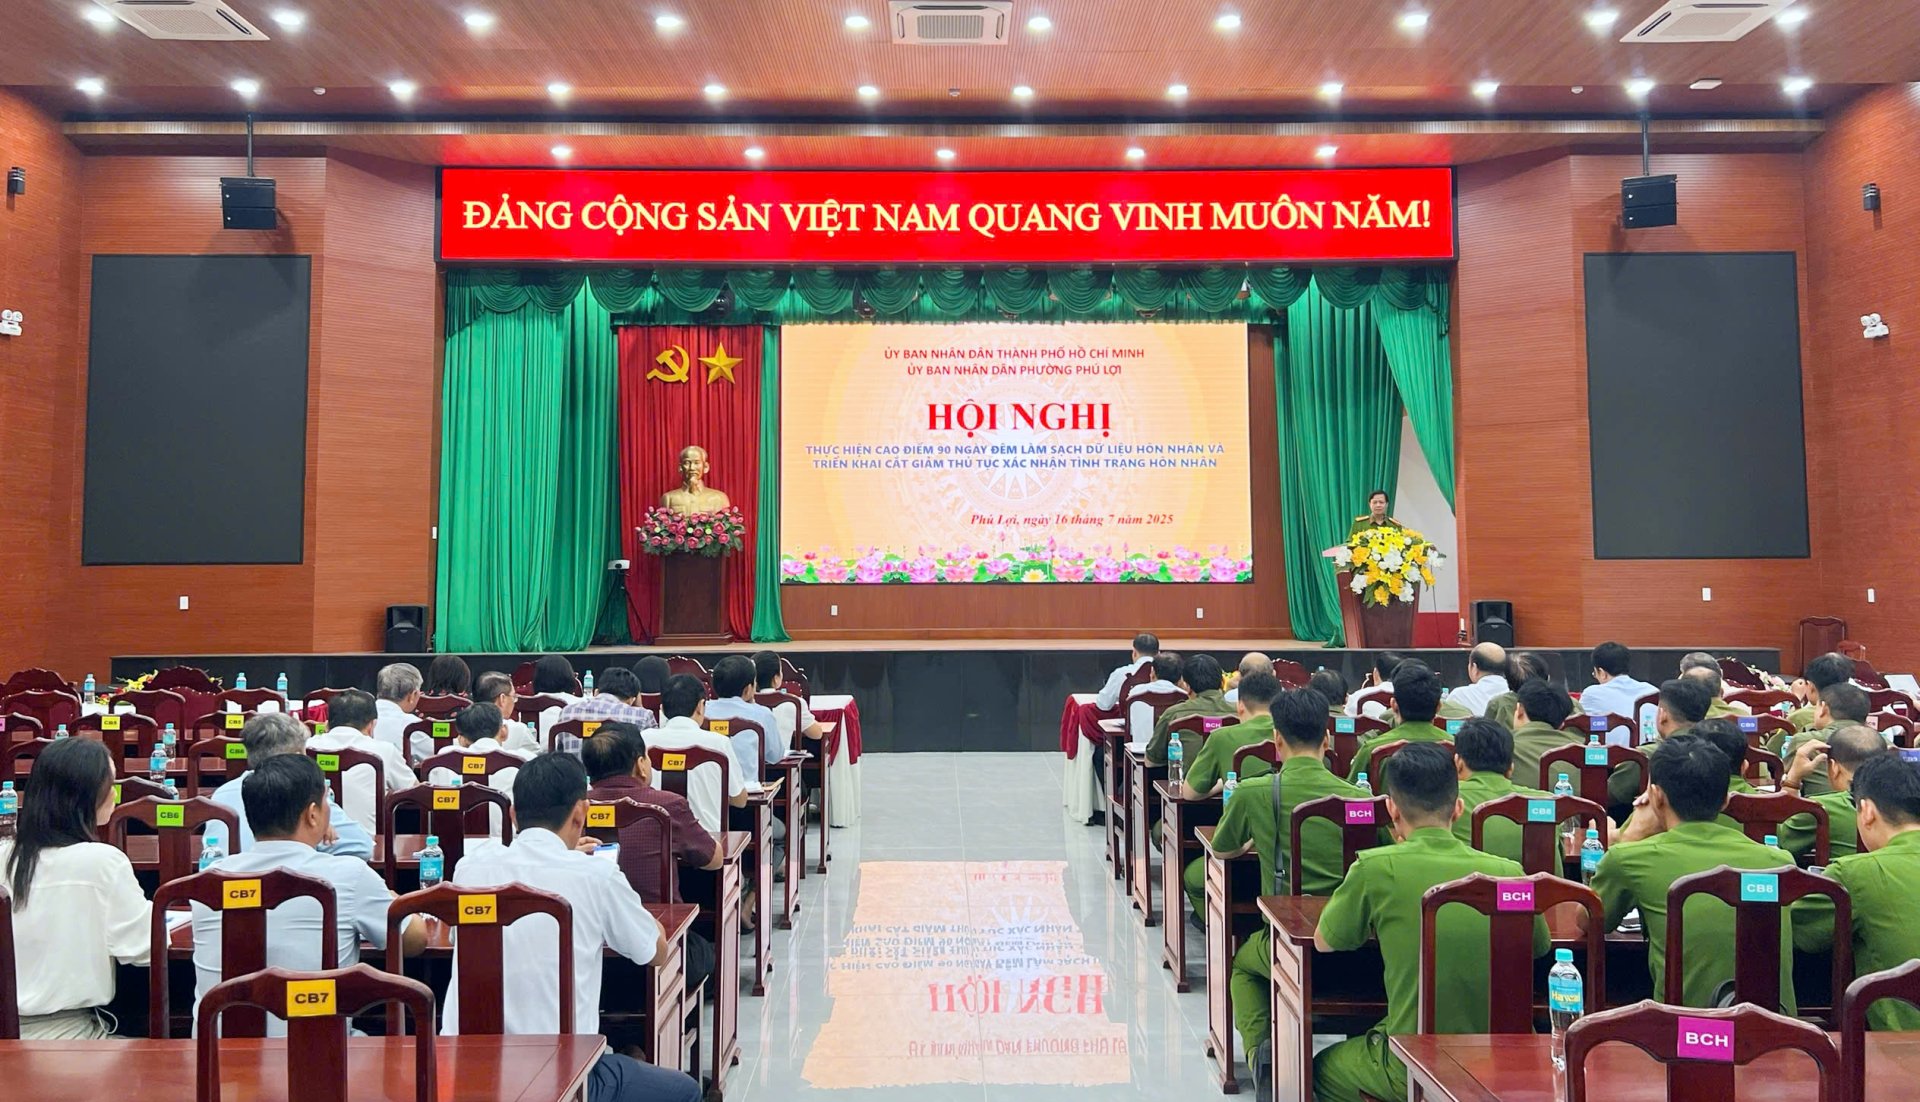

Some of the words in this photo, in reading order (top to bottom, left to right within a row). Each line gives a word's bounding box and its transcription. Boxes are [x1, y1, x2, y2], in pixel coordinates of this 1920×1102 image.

[463, 194, 573, 230] ĐẢNG
[582, 193, 688, 236] CỘNG
[698, 194, 772, 231] SẢN
[780, 198, 865, 237] VIỆT
[873, 204, 960, 231] NAM
[969, 203, 1101, 237] QUANG
[1109, 203, 1203, 231] VINH
[1210, 194, 1325, 230] MUÔN
[1332, 194, 1430, 229] NĂM!
[885, 346, 900, 359] ỦY
[903, 349, 927, 359] BAN
[931, 346, 965, 359] NHÂN
[969, 346, 993, 359] DÂN
[998, 346, 1037, 359] THÀNH
[1041, 345, 1066, 359] PHỐ
[1069, 344, 1086, 359] HỒ
[1089, 346, 1109, 359] CHÍ
[1112, 348, 1145, 359] MINH
[907, 362, 923, 375] ỦY
[926, 365, 950, 375] BAN
[954, 362, 988, 375] NHÂN
[992, 362, 1017, 375] DÂN
[1020, 361, 1072, 375] PHƯỜNG
[1076, 362, 1100, 375] PHÚ
[1103, 364, 1122, 377] LỢI
[928, 399, 997, 438] HỘI
[1013, 402, 1110, 438] NGHỊ
[806, 445, 840, 458] THỰC
[843, 443, 872, 457] HIỆN
[875, 445, 900, 455] CAO
[937, 445, 951, 455] 90
[955, 442, 987, 455] NGÀY
[991, 442, 1018, 455] ĐÊM
[1051, 445, 1082, 457] SẠCH
[1108, 442, 1132, 457] LIỆU
[1137, 442, 1164, 454] HÔN
[1168, 443, 1204, 454] NHÂN
[852, 459, 881, 469] KHAI
[976, 459, 999, 471] TỤC
[1003, 456, 1027, 468] XÁC
[1070, 456, 1100, 468] TÌNH
[1104, 458, 1146, 471] TRẠNG
[1150, 456, 1176, 468] HÔN
[1180, 456, 1217, 468] NHÂN
[971, 513, 994, 525] Phú
[1023, 515, 1050, 527] ngày
[1055, 514, 1068, 525] 16
[1071, 513, 1104, 527] tháng
[1109, 514, 1115, 525] 7
[1117, 514, 1143, 525] năm
[1146, 514, 1174, 525] 2025
[437, 796, 456, 804] CB7
[160, 811, 180, 819] CB6
[1349, 809, 1372, 818] BCH
[229, 888, 257, 898] CB7
[1746, 882, 1774, 893] CB8
[1502, 892, 1532, 902] BCH
[464, 905, 492, 915] CB7
[294, 992, 329, 1005] CB7
[1684, 1031, 1729, 1048] BCH
